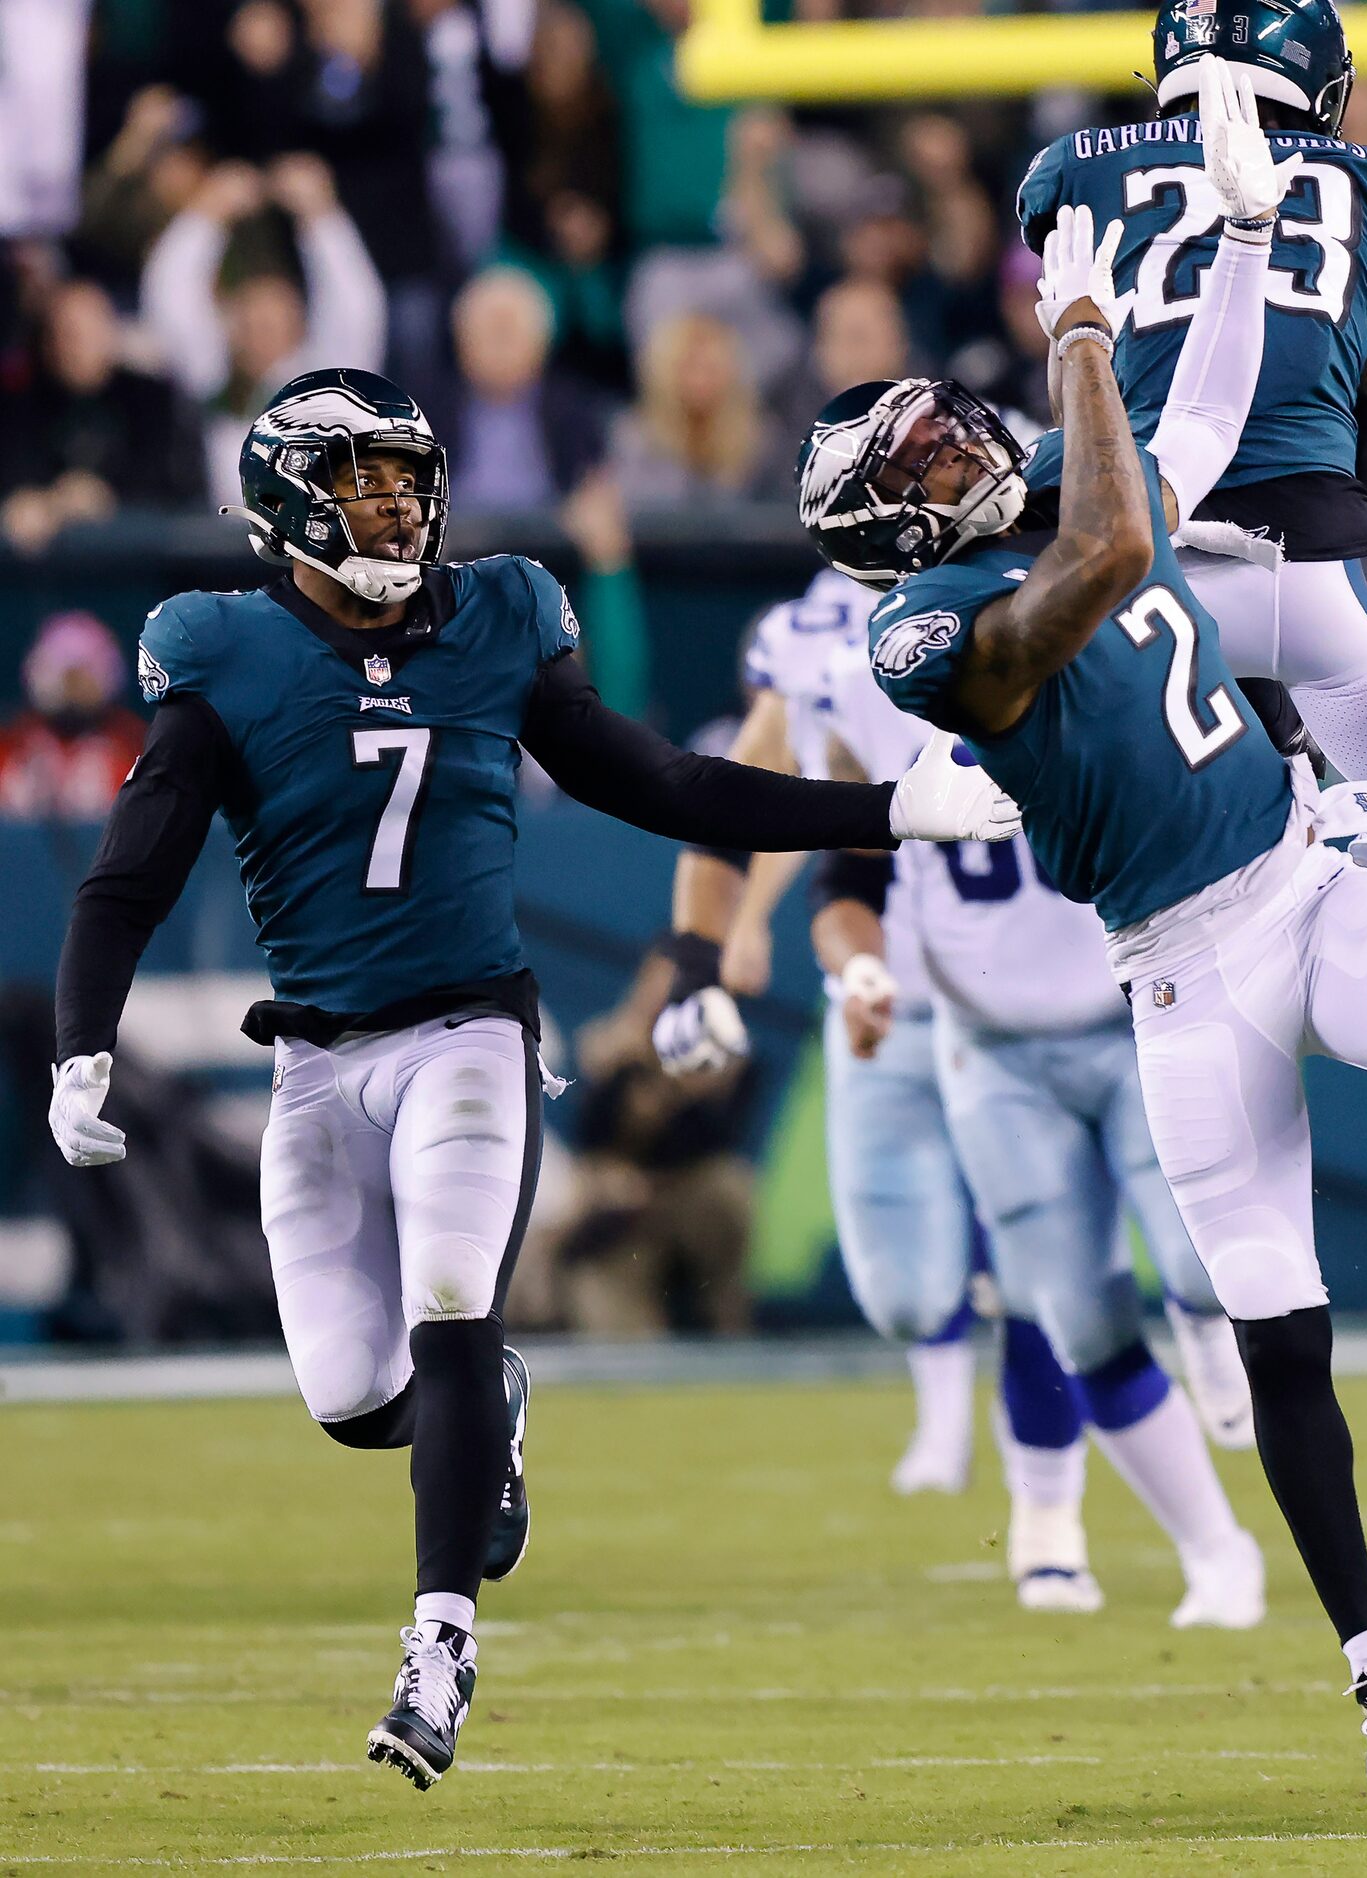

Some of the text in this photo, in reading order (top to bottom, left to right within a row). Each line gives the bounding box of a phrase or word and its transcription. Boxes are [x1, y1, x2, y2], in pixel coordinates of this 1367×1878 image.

[1122, 161, 1359, 337] 23
[357, 695, 413, 715] EAGLES
[1111, 583, 1250, 774] 2
[350, 724, 434, 896] 7
